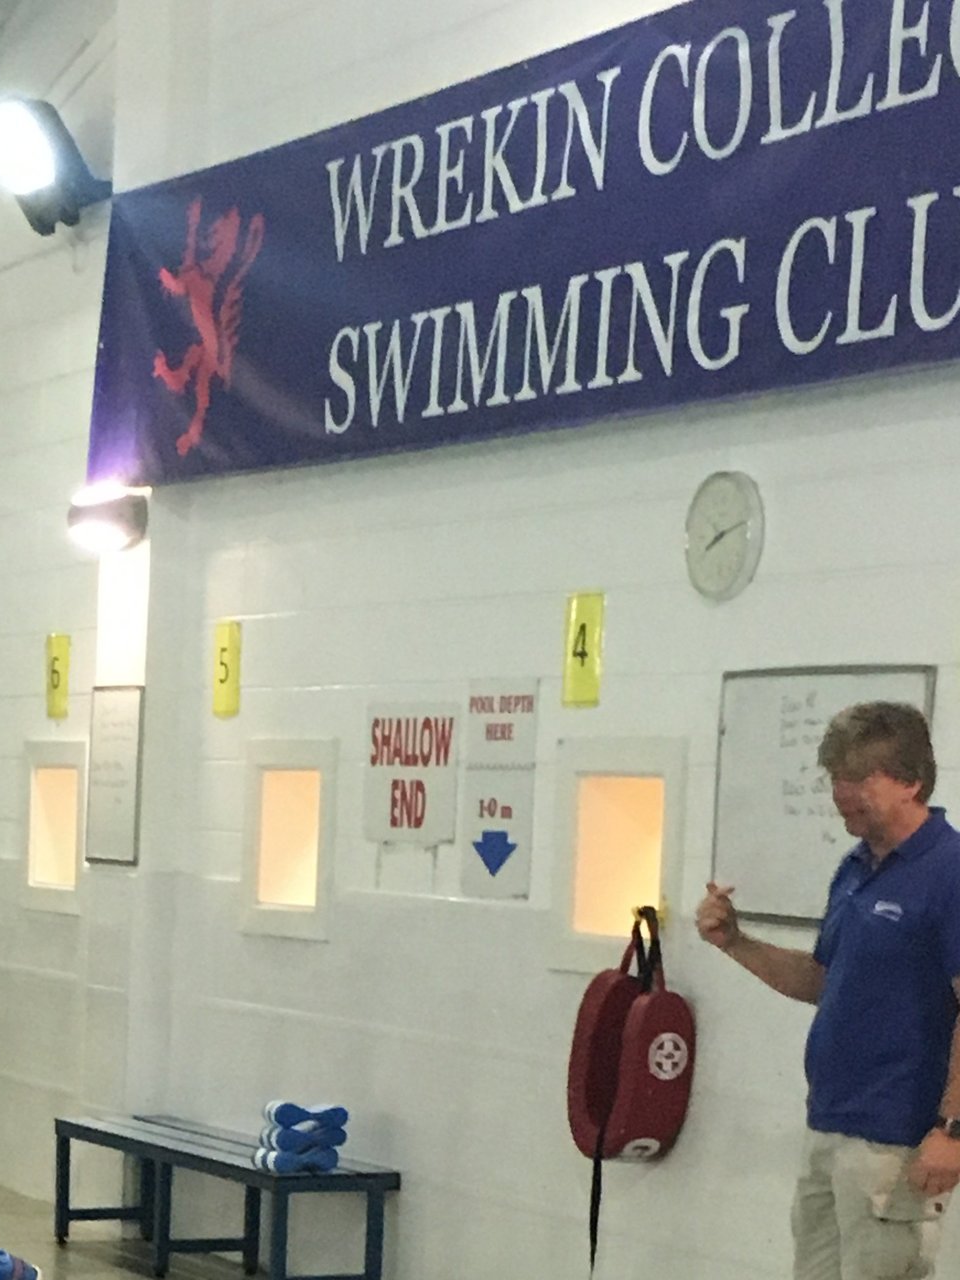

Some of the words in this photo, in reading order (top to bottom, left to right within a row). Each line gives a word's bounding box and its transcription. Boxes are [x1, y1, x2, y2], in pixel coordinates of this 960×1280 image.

[326, 66, 622, 261] WREKIN
[638, 0, 960, 175] COLLE
[325, 238, 749, 433] SWIMMING
[219, 648, 230, 684] 5
[572, 622, 588, 667] 4
[50, 655, 61, 690] 6
[499, 694, 534, 714] DEPTH
[370, 716, 454, 767] SHALLOW
[485, 722, 514, 741] HERE
[390, 779, 426, 828] END
